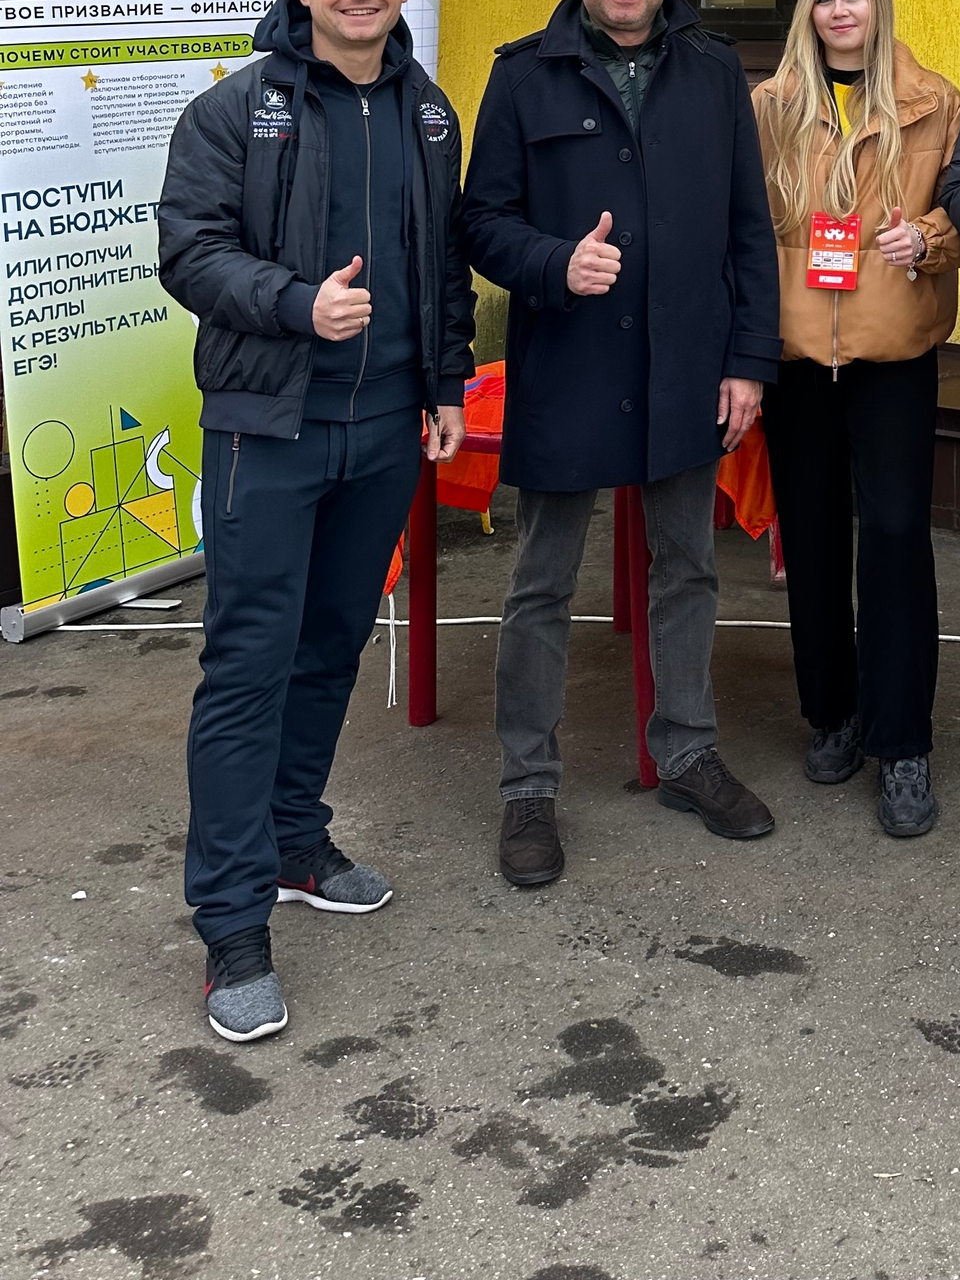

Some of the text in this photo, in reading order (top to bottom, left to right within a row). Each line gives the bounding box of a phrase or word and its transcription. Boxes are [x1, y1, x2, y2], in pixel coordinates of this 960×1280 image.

[0, 6, 45, 20] ВОЕ
[52, 3, 163, 19] ПРИЗВАНИЕ
[191, 0, 274, 14] ФИНАНСИ
[70, 46, 121, 60] СТОИТ
[127, 40, 249, 57] УЧАСТВОВАТЬ?
[131, 73, 179, 82] отборочного
[34, 99, 48, 107] без
[0, 108, 56, 119] ступительных
[0, 118, 41, 128] спытаний
[0, 128, 43, 137] рограммы,
[0, 134, 69, 146] оответствующие
[147, 141, 169, 149] испыт
[1, 179, 123, 213] ПОСТУПИ
[3, 201, 159, 242] НА БЮДЖЕТ
[6, 243, 133, 278] ИЛИ ПОЛУЧИ
[10, 299, 85, 327] БАЛЛЫ
[12, 306, 168, 352] К РЕЗУЛЬТАТАМ
[14, 352, 58, 376] ЕГЭ!
